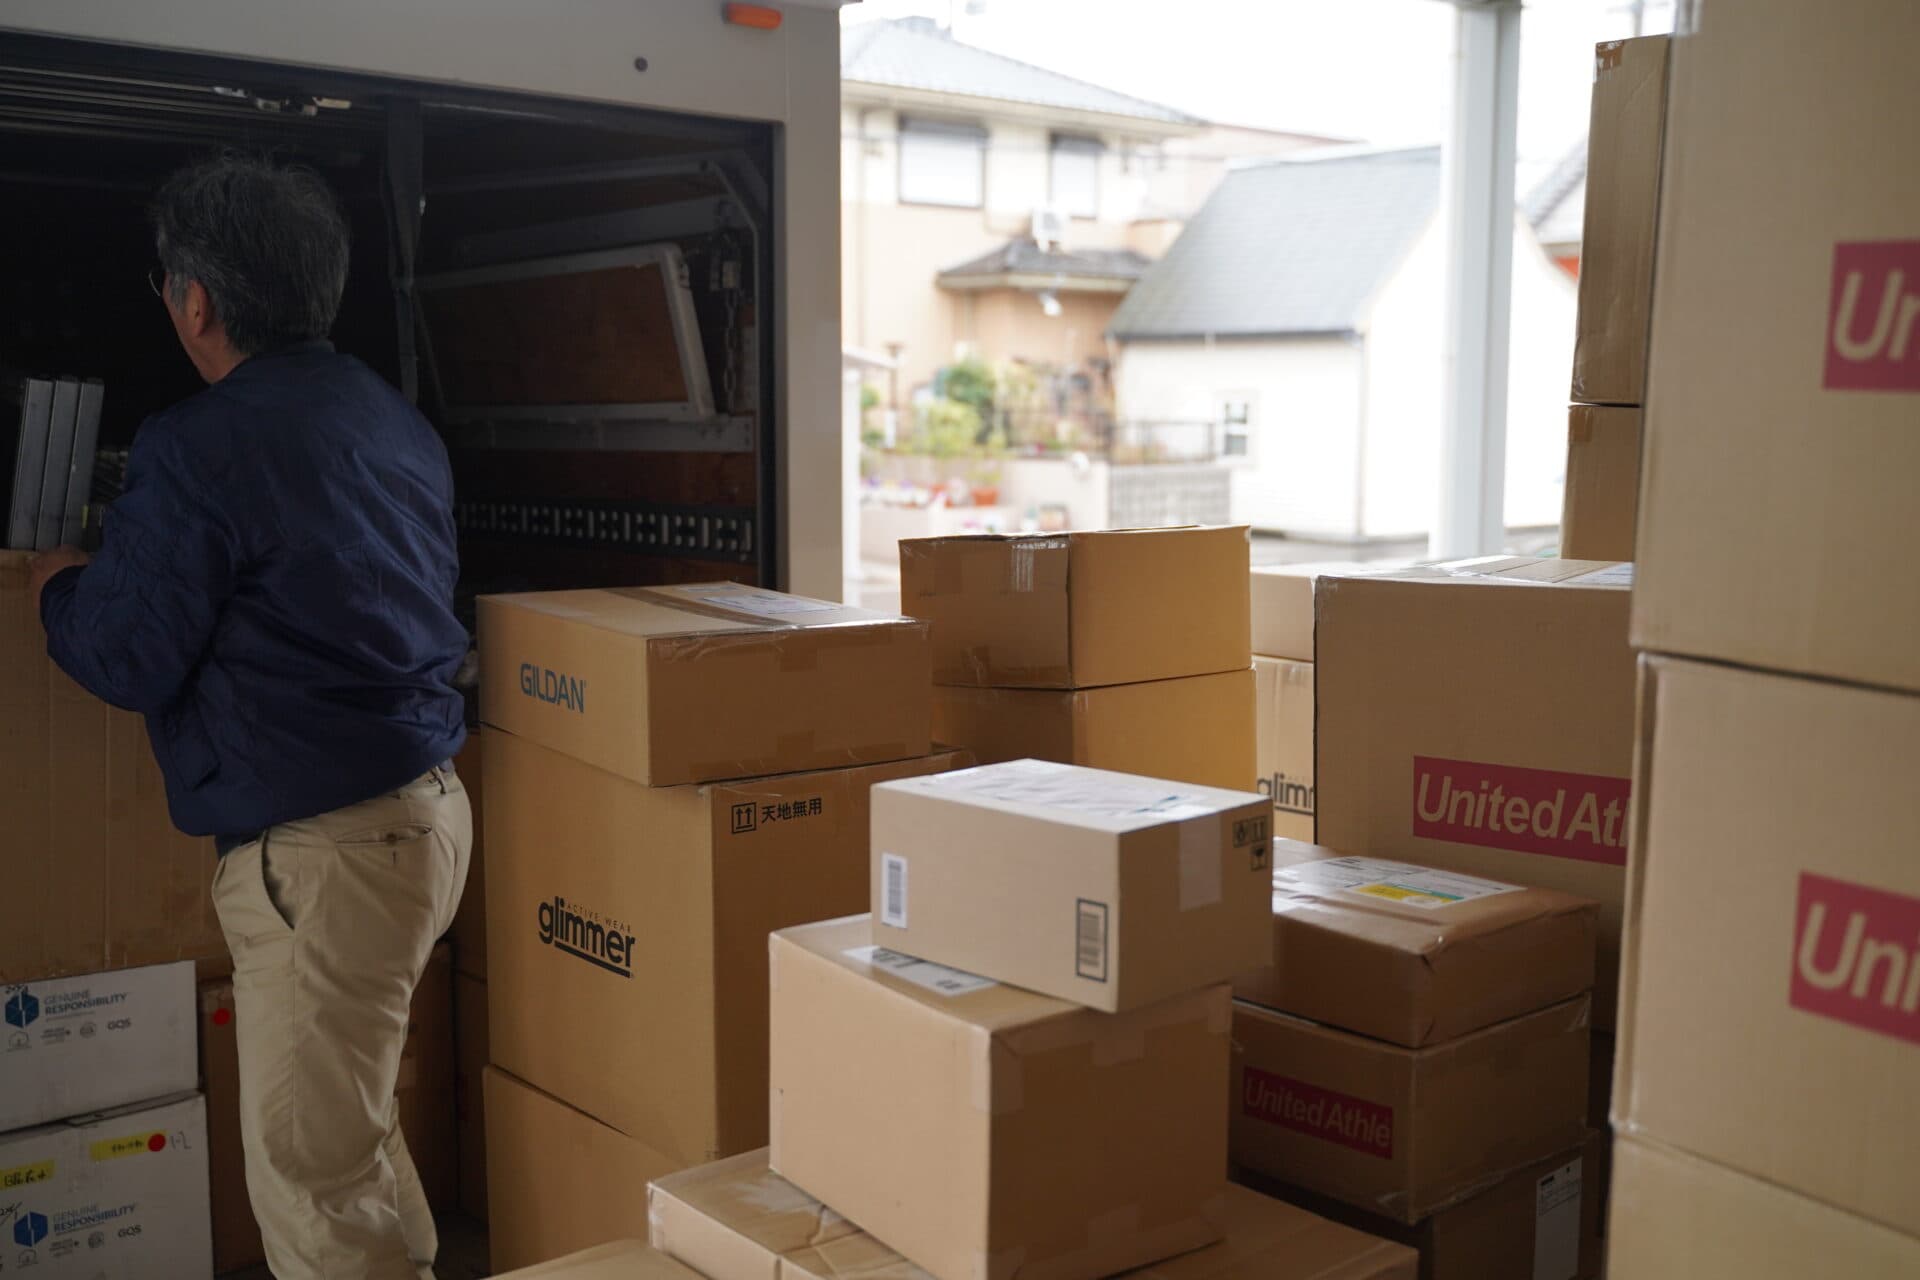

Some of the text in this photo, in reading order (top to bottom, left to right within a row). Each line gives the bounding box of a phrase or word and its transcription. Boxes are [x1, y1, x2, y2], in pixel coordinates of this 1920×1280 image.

[761, 797, 823, 825] 天地無用
[538, 895, 635, 967] glimmer
[45, 993, 128, 1015] RESPONSIBILITY
[54, 1204, 136, 1232] RESPONSIBILITY
